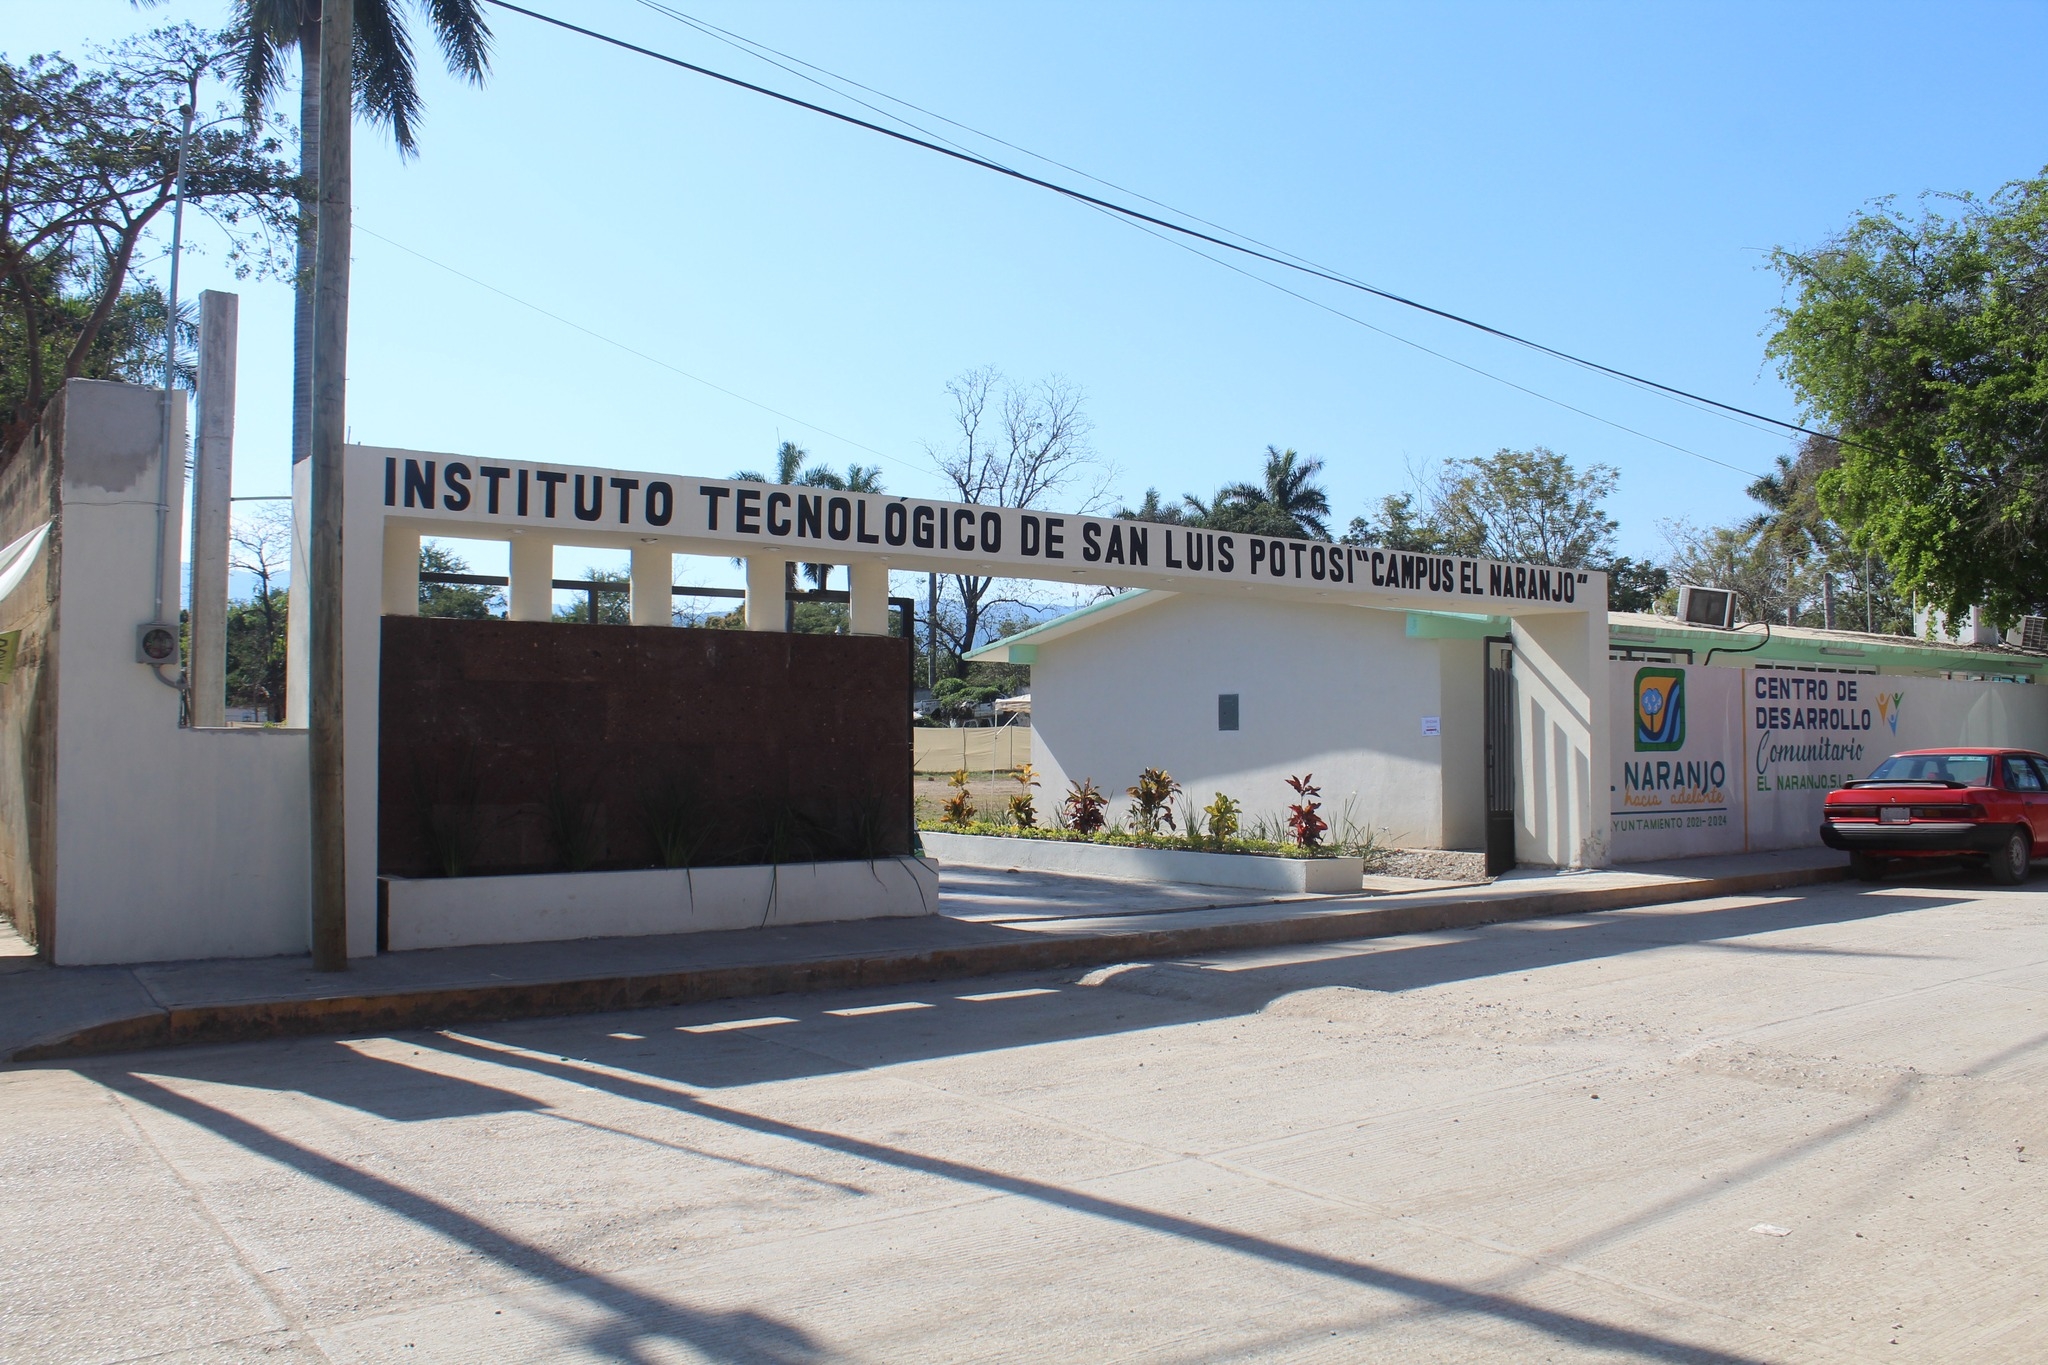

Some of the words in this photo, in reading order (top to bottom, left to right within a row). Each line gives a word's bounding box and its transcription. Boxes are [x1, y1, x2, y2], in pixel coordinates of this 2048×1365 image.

[385, 457, 674, 527] INSTITUTO
[699, 485, 1001, 554] TECNOLÓGICO
[1020, 514, 1065, 559] DE
[1082, 521, 1149, 567] SAN
[1165, 529, 1235, 573] LUIS
[1460, 560, 1484, 595] EL
[1755, 676, 1828, 701] CENTRO
[1837, 680, 1858, 702] DE
[1755, 706, 1872, 731] DESARROLLO
[1756, 730, 1865, 775] Comunitario
[1624, 760, 1726, 795] NARANJO
[1757, 776, 1771, 791] EL
[1624, 785, 1662, 807] hacia
[1670, 784, 1725, 805] adelante
[1611, 817, 1683, 832] YUNTAMIENTO
